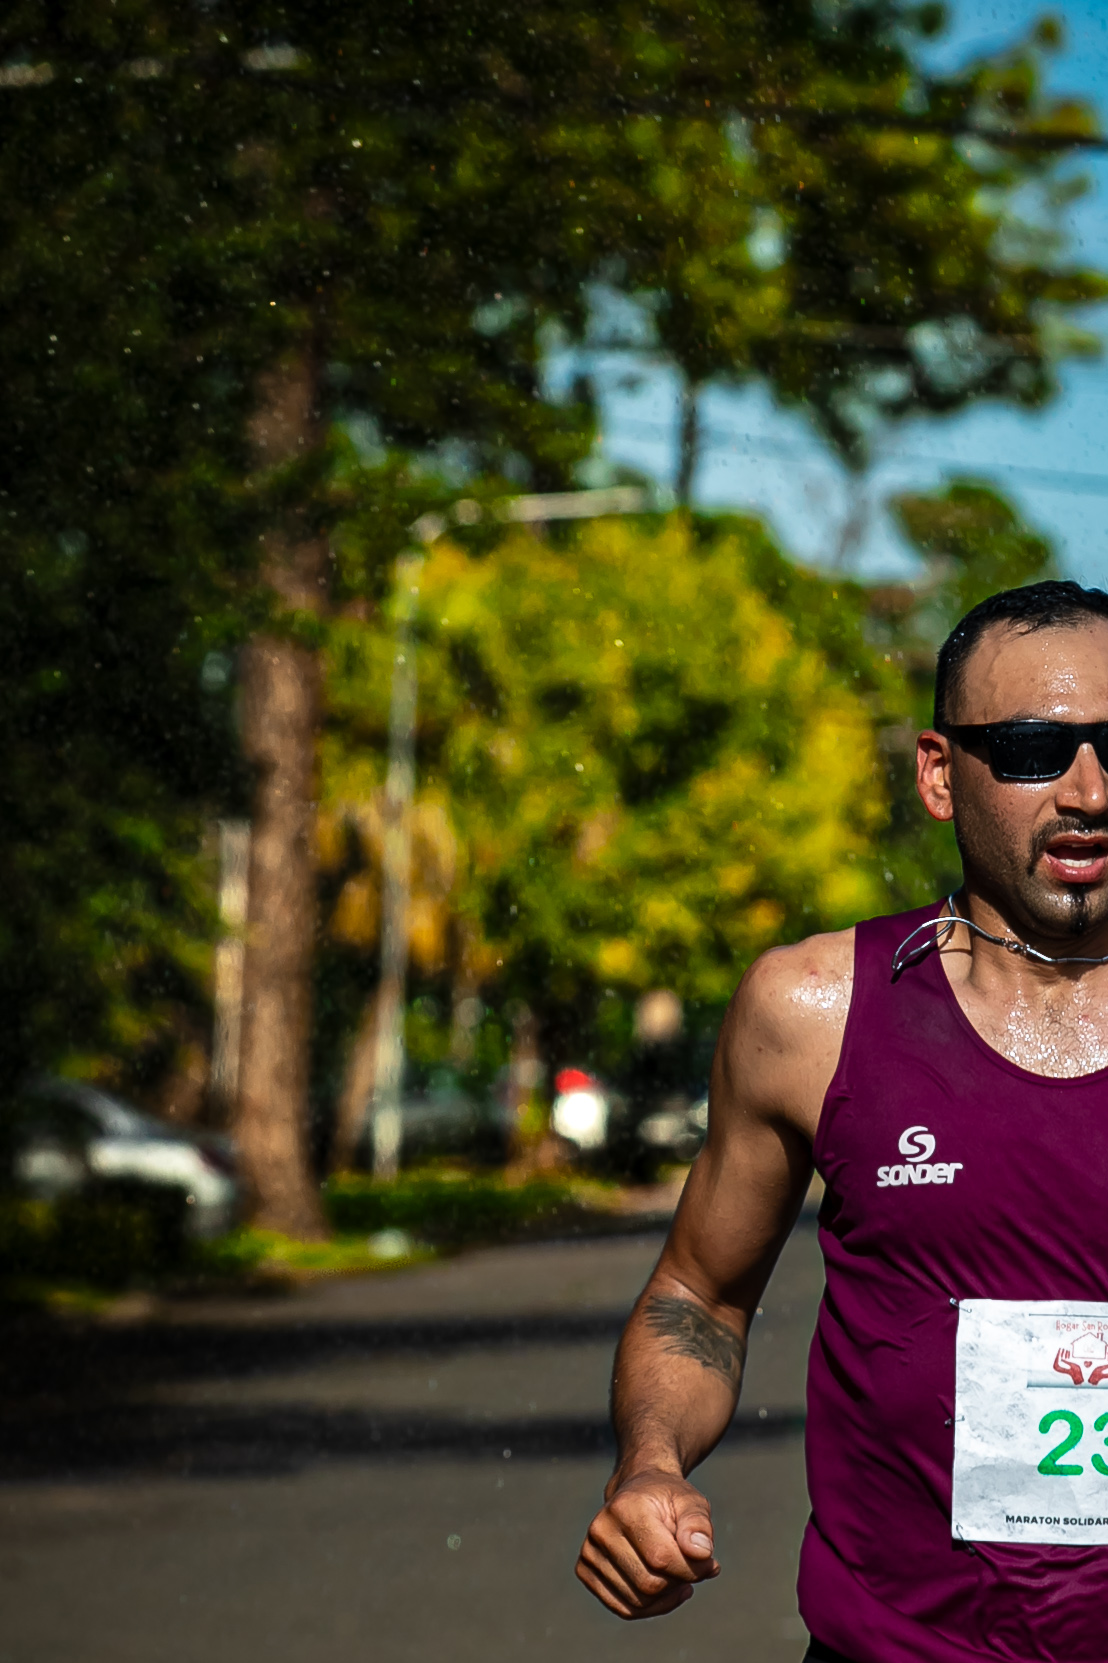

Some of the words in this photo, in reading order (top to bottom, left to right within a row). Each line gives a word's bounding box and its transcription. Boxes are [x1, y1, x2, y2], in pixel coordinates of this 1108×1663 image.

[1055, 1319, 1080, 1332] Hogar
[1081, 1320, 1096, 1332] San
[1005, 1515, 1061, 1525] MARATON
